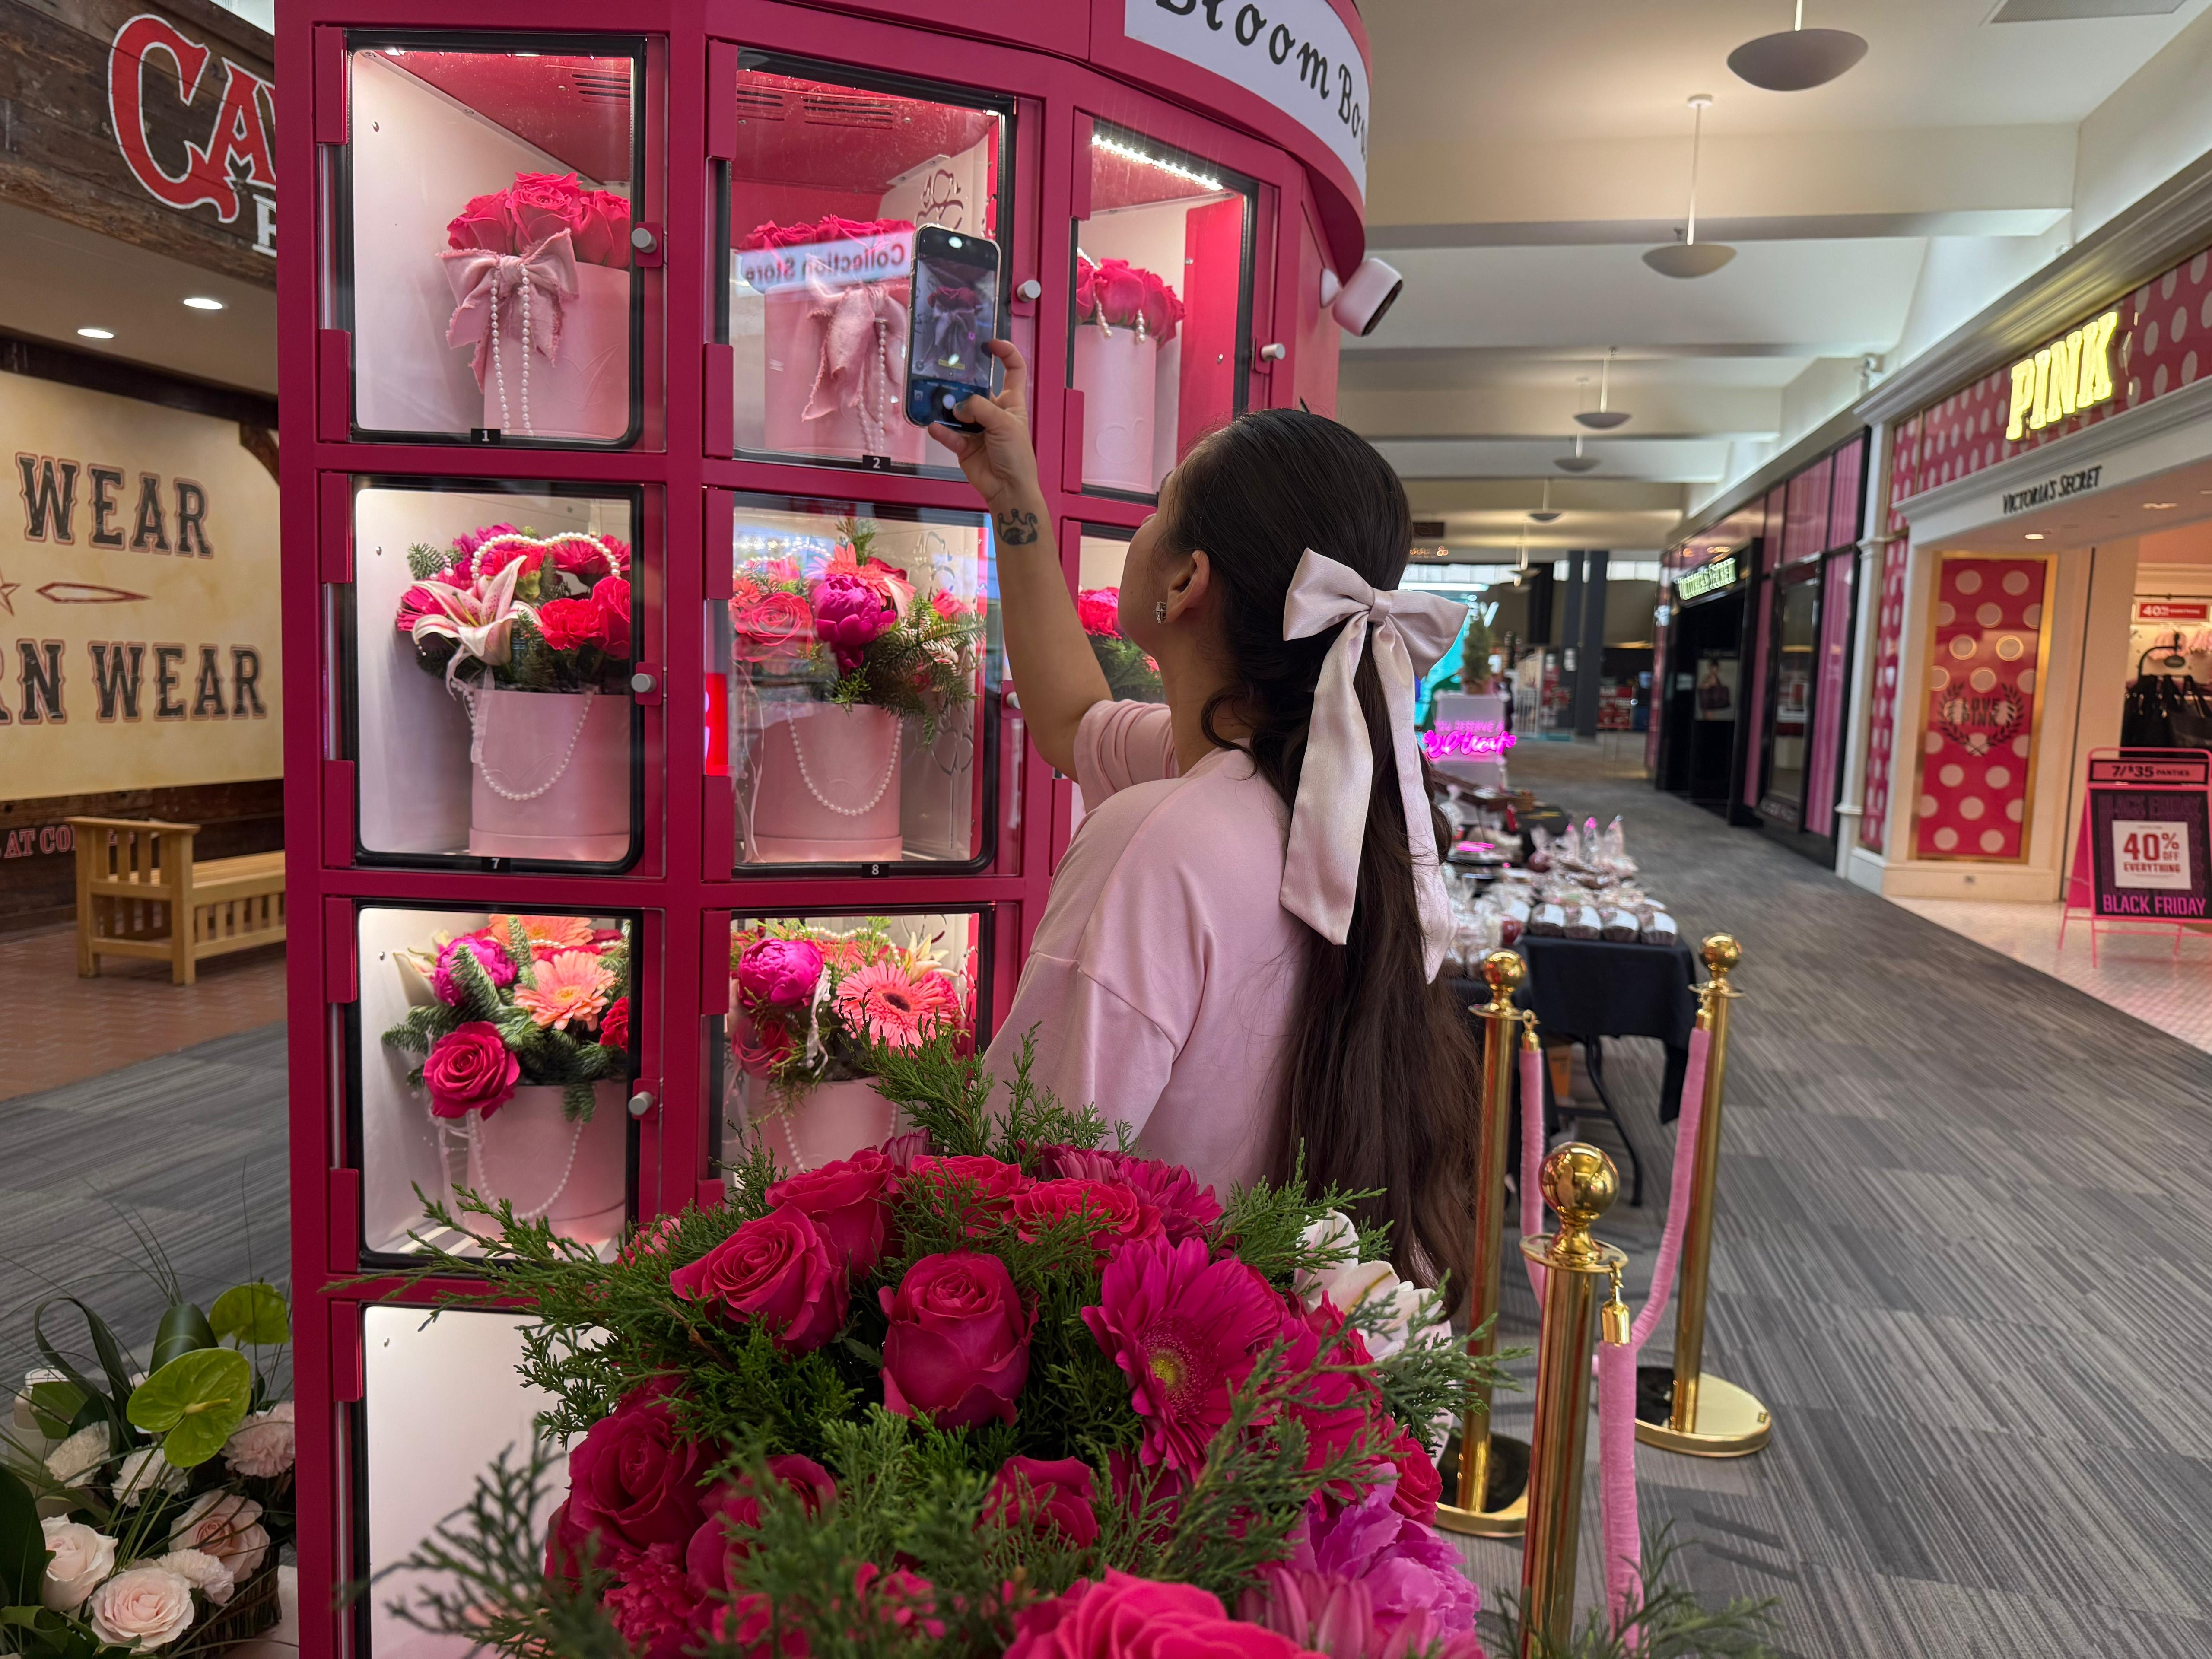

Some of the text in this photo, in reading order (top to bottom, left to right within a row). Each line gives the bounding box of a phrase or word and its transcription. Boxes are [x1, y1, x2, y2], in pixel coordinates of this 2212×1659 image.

[108, 13, 276, 223] CA
[2005, 311, 2118, 441] PINK
[482, 429, 490, 442] 1
[873, 457, 880, 469] 2
[2058, 464, 2103, 497] SECRET
[16, 452, 214, 559] WEAR
[88, 641, 267, 722] WEAR
[4, 828, 36, 859] AT
[491, 858, 500, 870] 7
[872, 864, 880, 876] 8
[2123, 862, 2181, 874] EVERYTHING
[2102, 894, 2206, 916] BLACK FRIDAY
